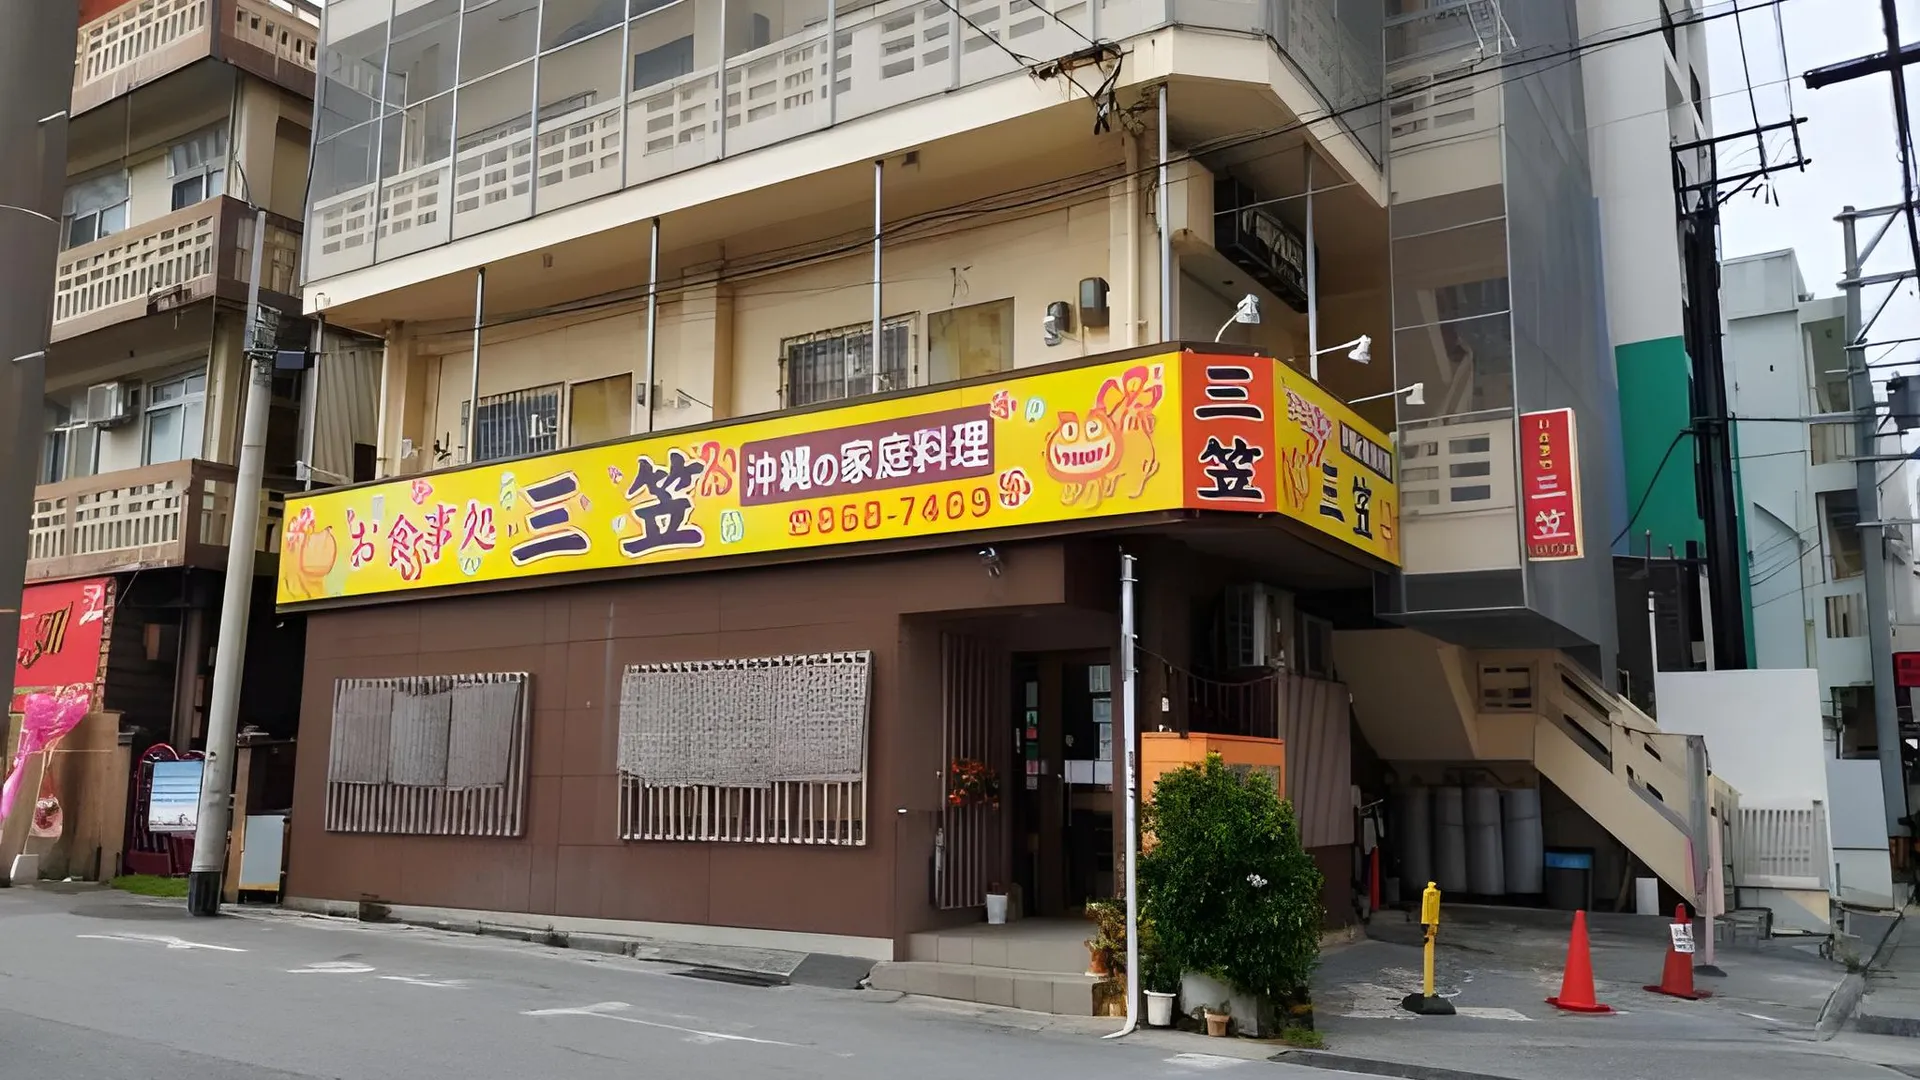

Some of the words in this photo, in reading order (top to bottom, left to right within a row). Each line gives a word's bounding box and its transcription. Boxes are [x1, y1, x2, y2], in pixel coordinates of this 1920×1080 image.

[747, 419, 989, 497] 沖縄の家庭料理
[1194, 366, 1265, 502] 三笠
[346, 499, 496, 581] お食事処
[510, 447, 704, 566] 三笠
